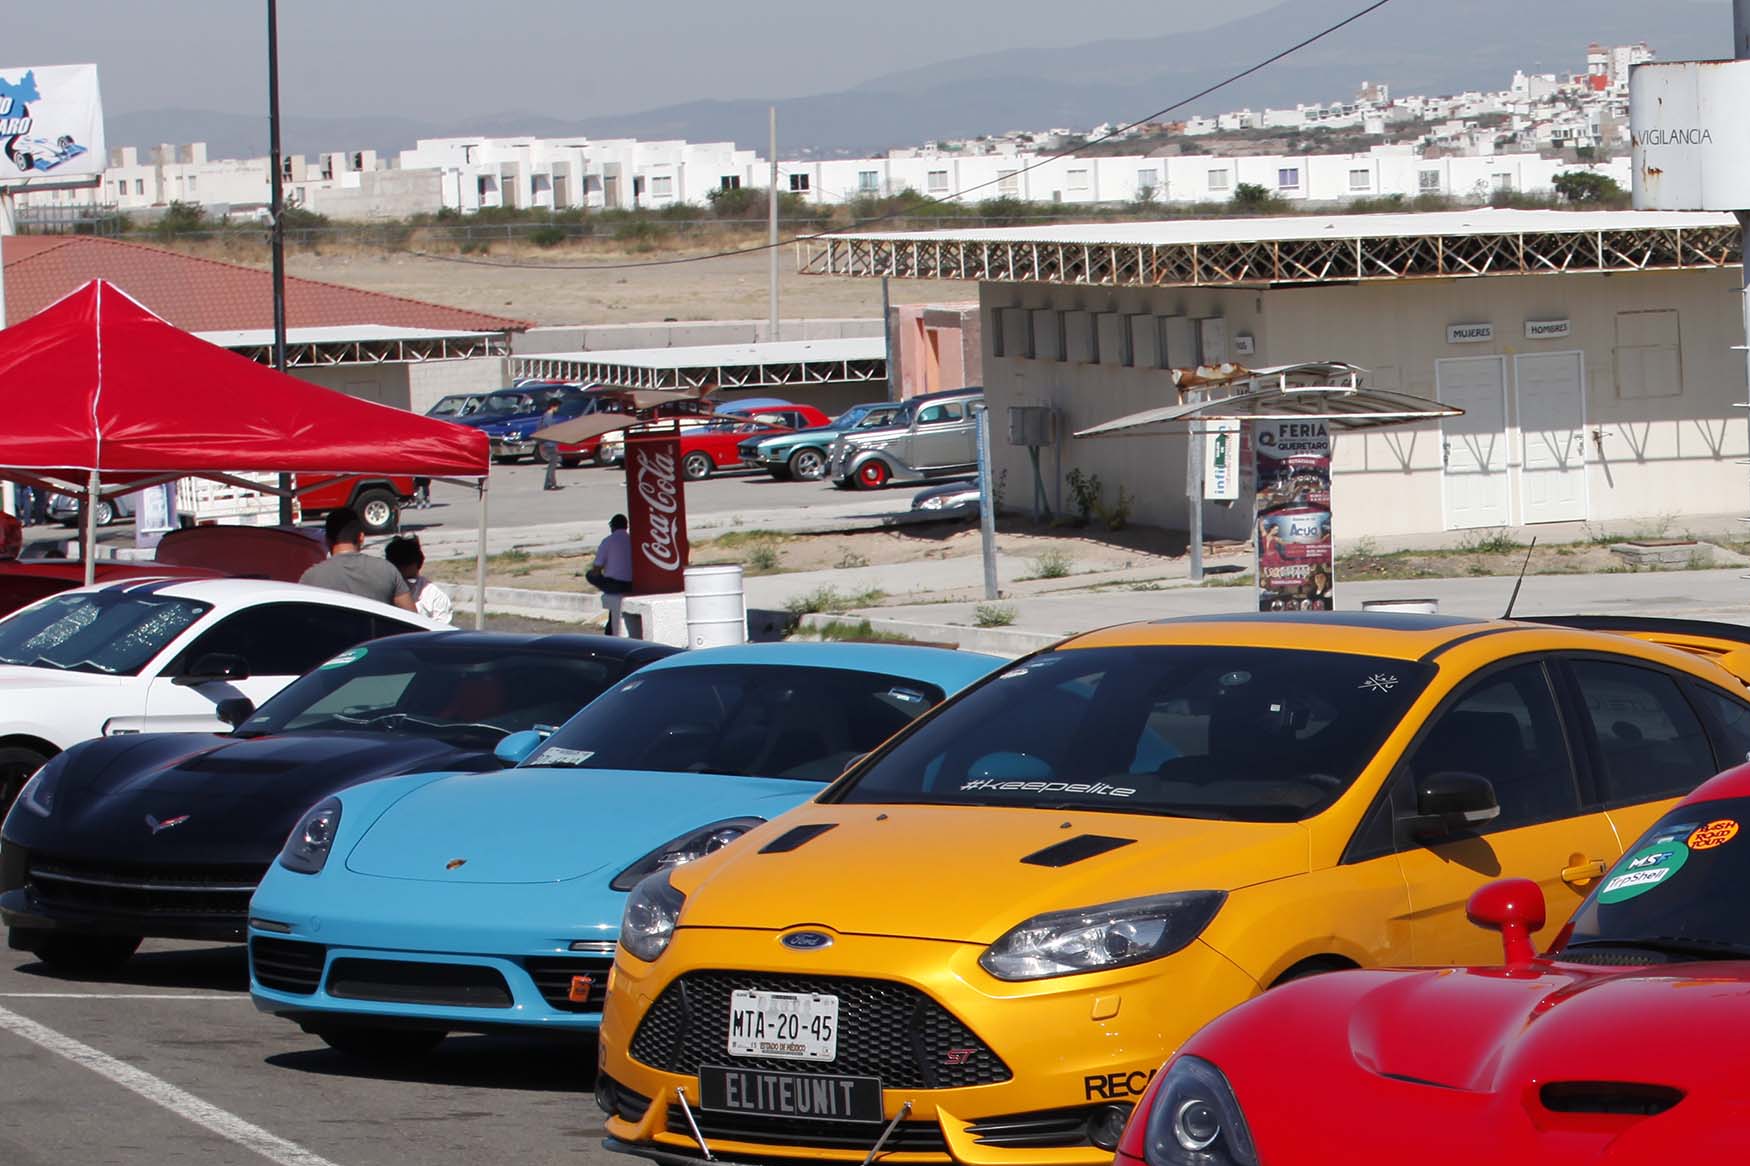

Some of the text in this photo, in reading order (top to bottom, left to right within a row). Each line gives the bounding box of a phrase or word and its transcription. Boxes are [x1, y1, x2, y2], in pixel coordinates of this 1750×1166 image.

[1638, 129, 1713, 145] VIGILANCIA
[1453, 328, 1490, 339] MUJERES
[1280, 423, 1328, 438] FERIA
[960, 778, 1137, 798] #keepelite
[1628, 852, 1674, 870] MSF
[733, 1009, 832, 1042] MTA-20-45
[944, 1048, 977, 1065] ST
